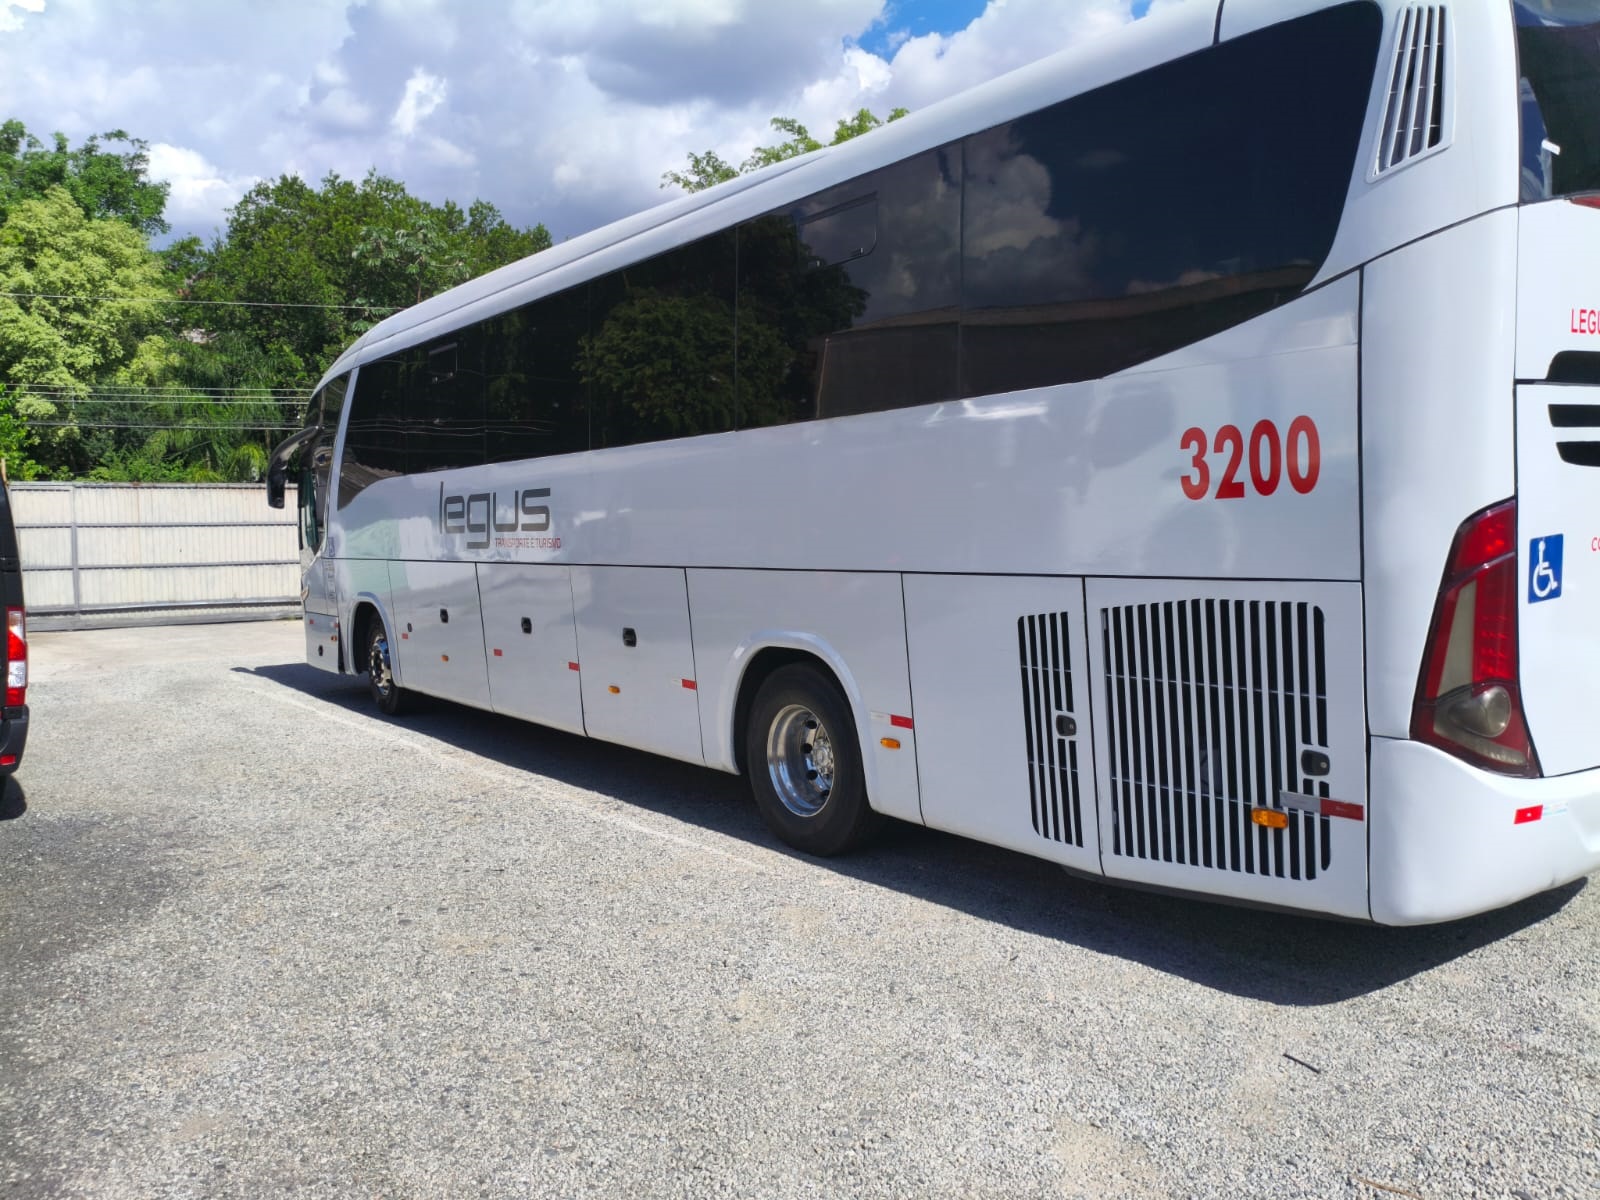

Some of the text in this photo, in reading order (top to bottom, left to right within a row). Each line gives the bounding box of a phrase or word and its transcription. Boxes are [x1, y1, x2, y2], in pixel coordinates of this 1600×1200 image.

[1571, 308, 1600, 335] LEG
[1180, 415, 1321, 501] 3200
[440, 481, 551, 549] legus
